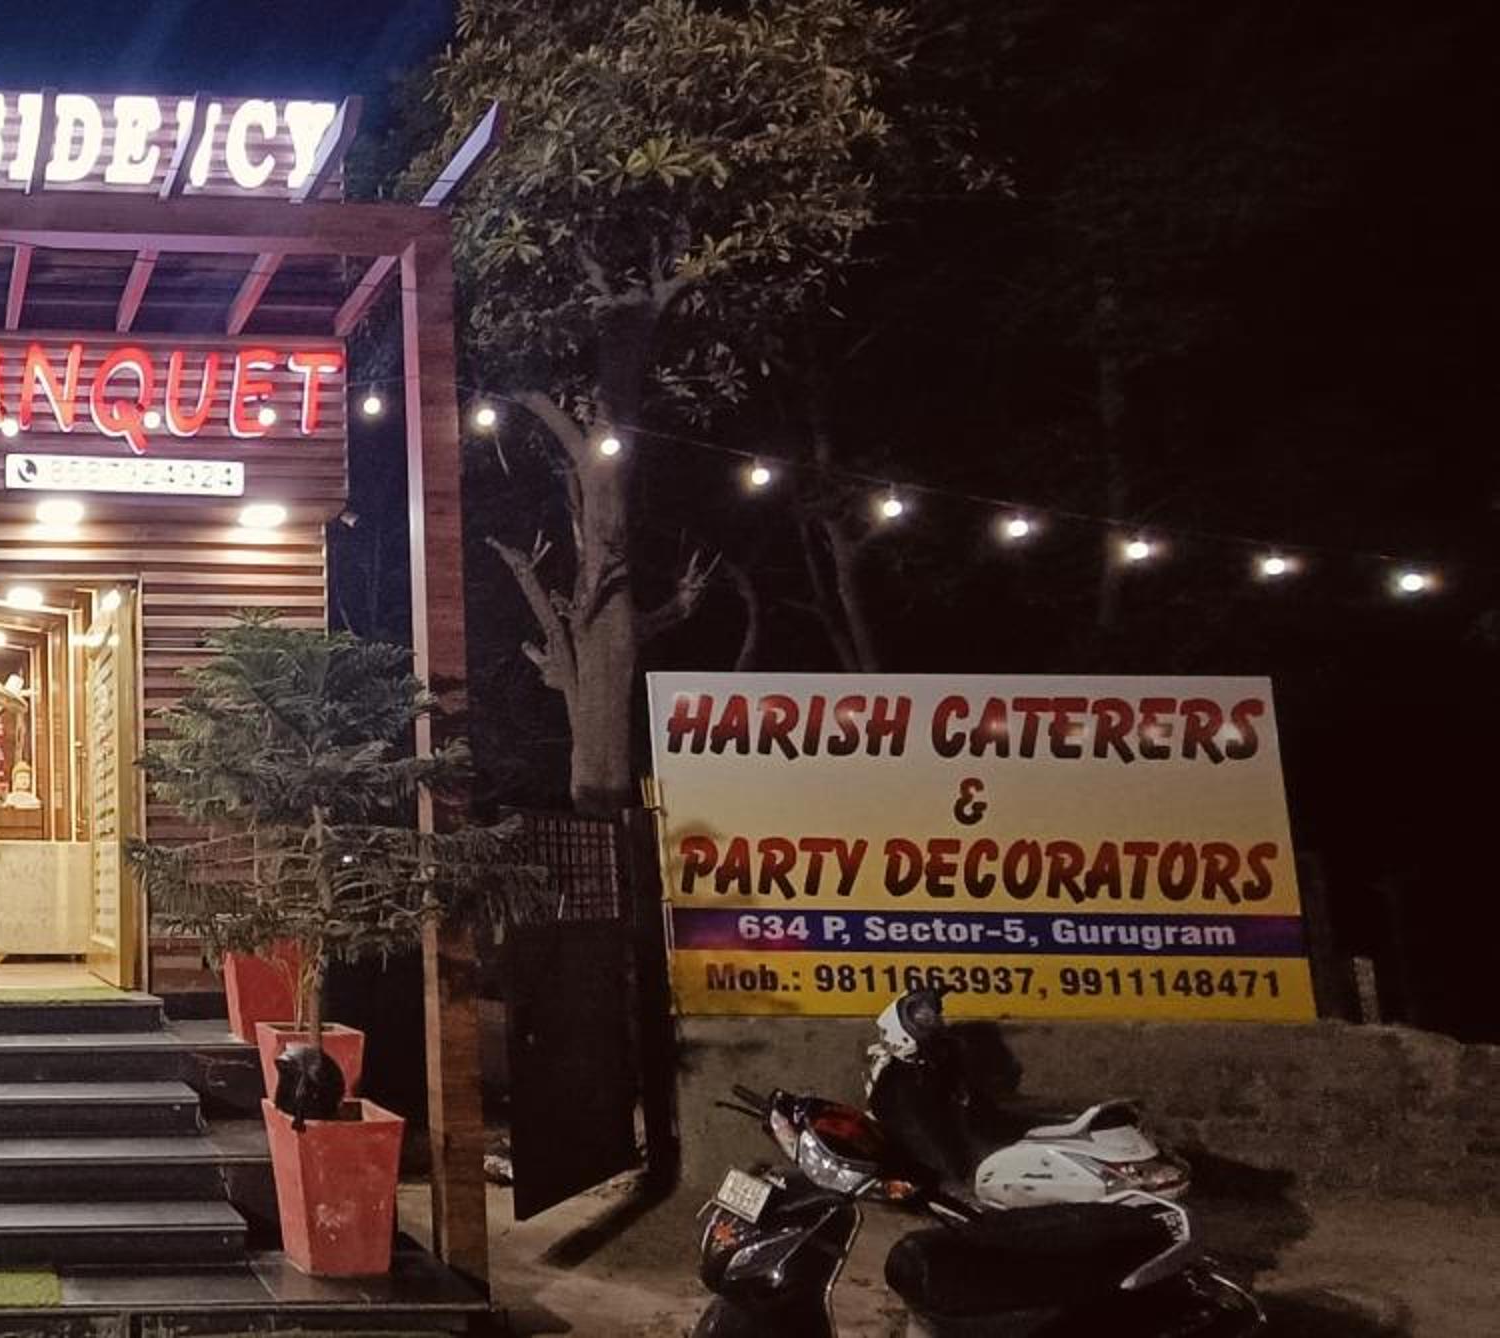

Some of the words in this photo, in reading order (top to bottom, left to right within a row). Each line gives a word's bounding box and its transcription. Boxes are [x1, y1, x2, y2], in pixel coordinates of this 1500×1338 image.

[667, 694, 912, 760] HARISH
[931, 695, 1266, 764] CATERERS
[954, 777, 988, 826] &
[680, 836, 869, 900] PARTY
[883, 838, 1278, 904] DECORATORS
[738, 915, 809, 941] 634
[823, 916, 851, 945] P,
[864, 916, 1040, 947] Sector-5,
[1051, 919, 1237, 949] Gurugram
[705, 963, 801, 992] Mob.:
[815, 964, 1048, 999] 9811663937,
[1060, 967, 1281, 997] 9911148471
